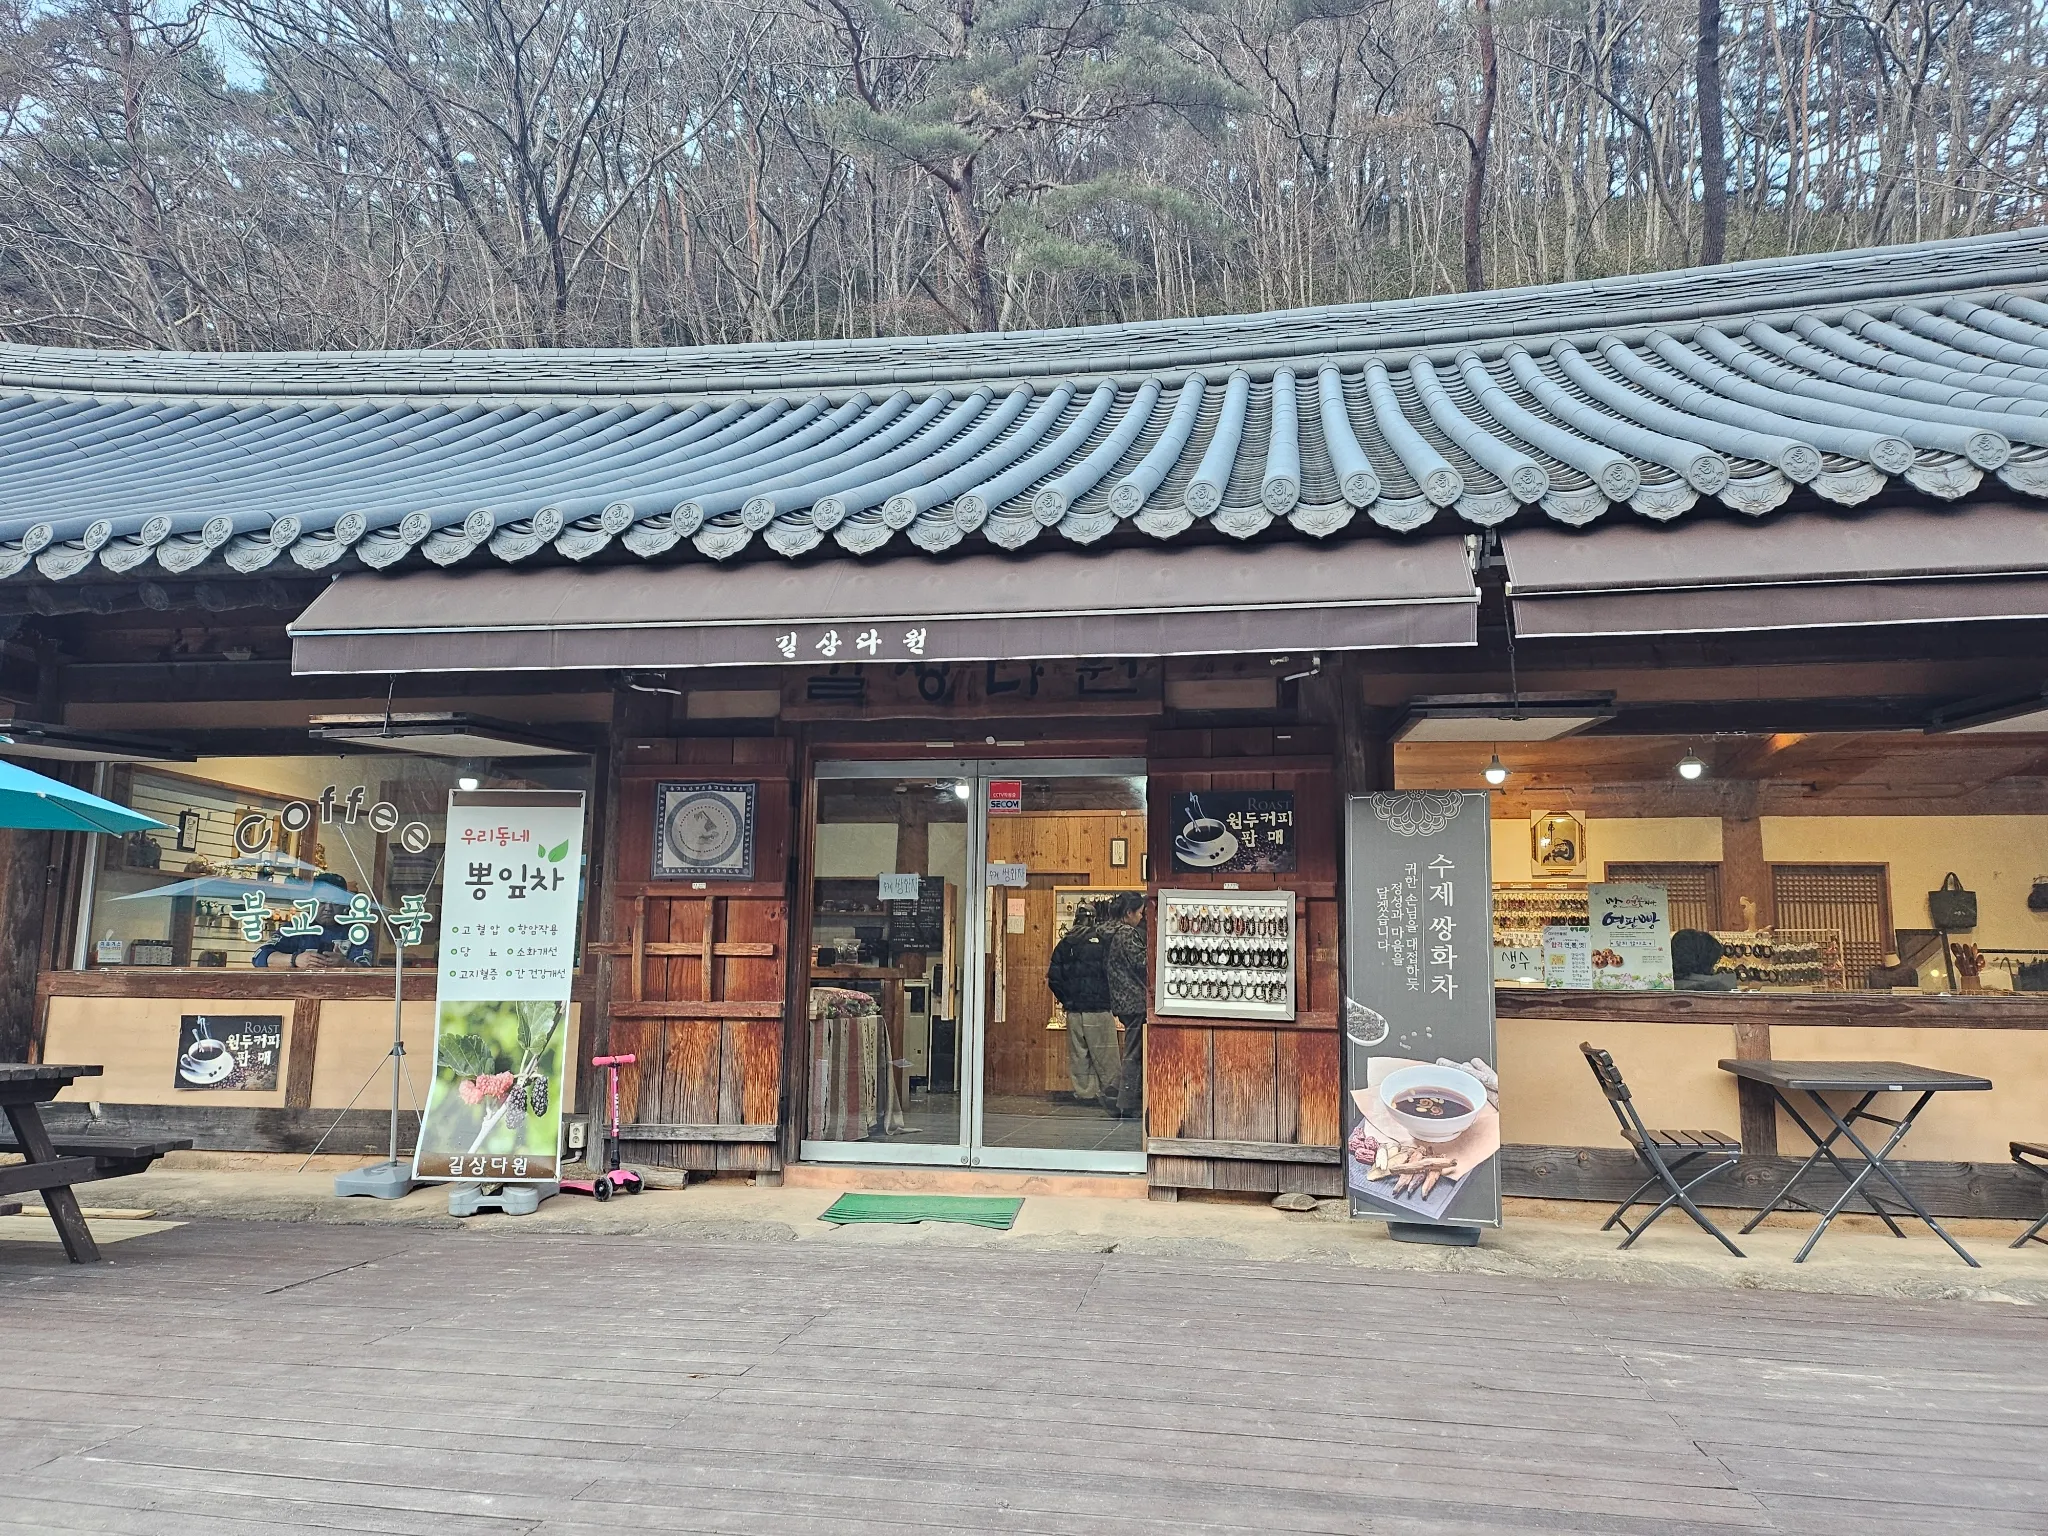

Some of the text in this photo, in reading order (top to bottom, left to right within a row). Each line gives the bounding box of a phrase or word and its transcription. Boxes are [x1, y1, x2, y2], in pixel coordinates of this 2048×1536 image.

[776, 628, 927, 658] 길상다원
[990, 800, 1019, 808] SECOM
[234, 785, 431, 854] coffee
[1226, 811, 1293, 830] 원두커피
[461, 827, 530, 847] 우리동네
[1241, 829, 1284, 848] 판매
[465, 862, 565, 901] 뽕잎차
[229, 890, 433, 946] 불교용품
[1391, 882, 1405, 966] 정성과 마음을
[1404, 862, 1420, 991] 귀한 손님을 대접하듯
[1428, 853, 1458, 1000] 수제 쌍화차
[517, 924, 558, 936] 항암작용
[516, 946, 558, 957] 소화개선
[1501, 950, 1530, 970] 생수
[459, 968, 498, 980] 고지혈증
[528, 968, 566, 979] 건강개선
[226, 1033, 280, 1051] 원두커피
[236, 1050, 272, 1067] 판매
[449, 1155, 528, 1176] 길상다원
